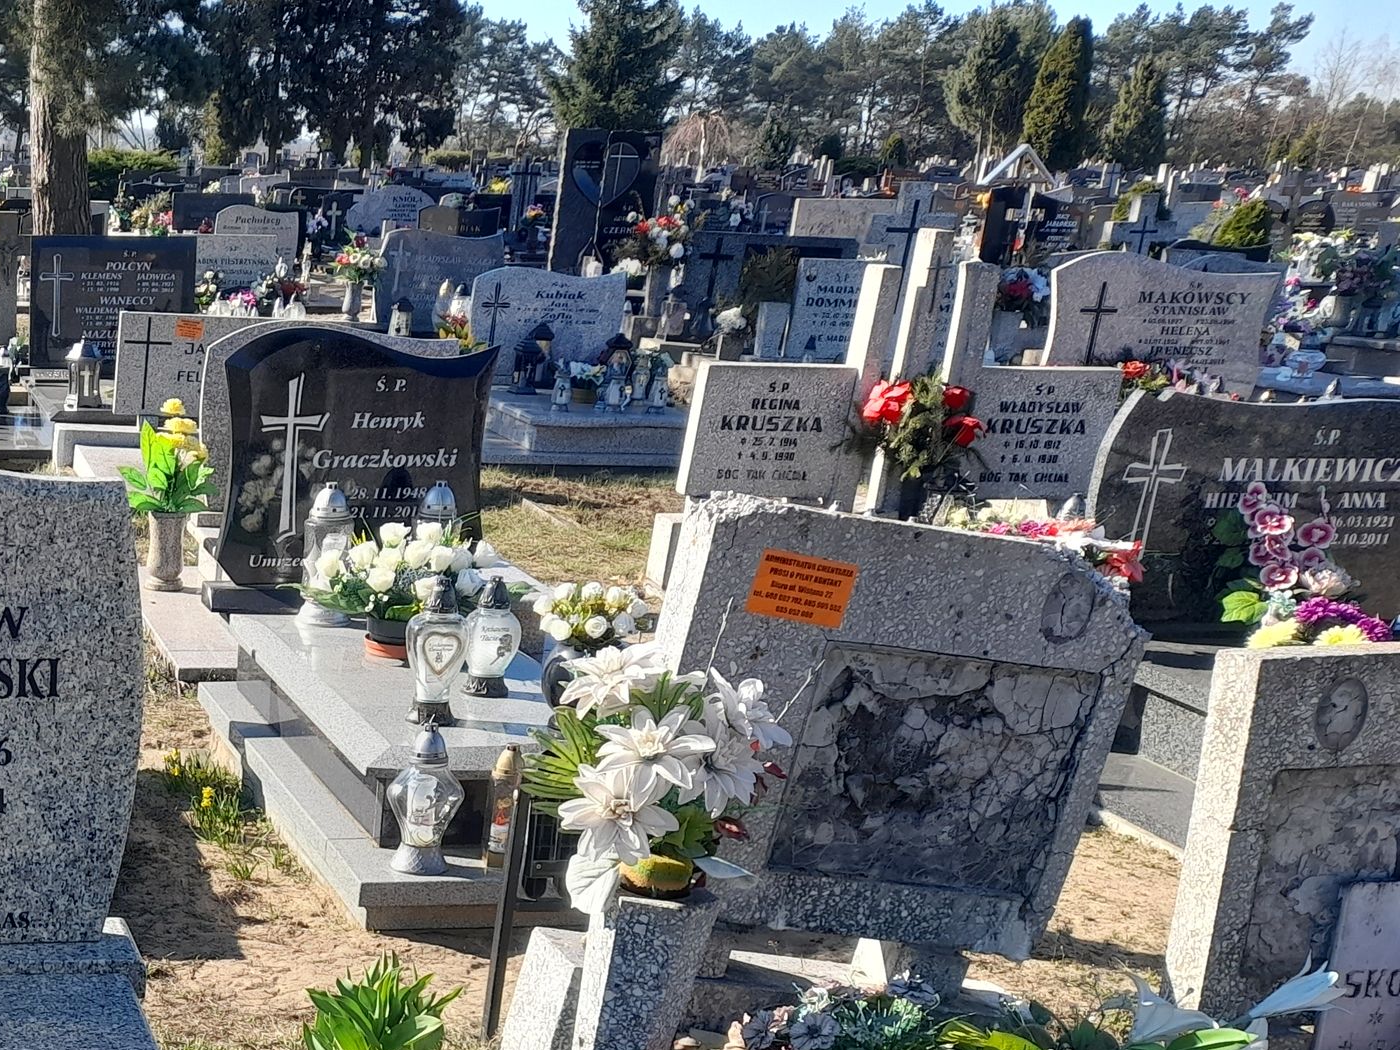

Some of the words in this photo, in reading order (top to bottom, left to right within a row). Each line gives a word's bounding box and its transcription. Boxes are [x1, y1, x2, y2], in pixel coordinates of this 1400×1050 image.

[105, 261, 152, 271] POLCYN
[80, 272, 123, 280] KLEMENS
[136, 272, 176, 281] JADWIGA
[100, 296, 156, 305] WANECCY
[535, 290, 587, 300] Kubiak
[548, 300, 569, 308] Jan
[1160, 326, 1210, 336] HELENA
[184, 342, 205, 355] JA
[177, 370, 200, 383] FEL
[751, 398, 800, 410] REGINA
[1000, 400, 1084, 414] WŁADYSŁAW
[351, 411, 425, 433] Henryk
[720, 415, 823, 433] KRUSZKA
[985, 417, 1086, 435] KRUSZKA
[312, 448, 458, 470] Graczkowski
[746, 469, 767, 480] TAK
[1008, 472, 1029, 483] TAK
[1336, 492, 1387, 508] ANNA
